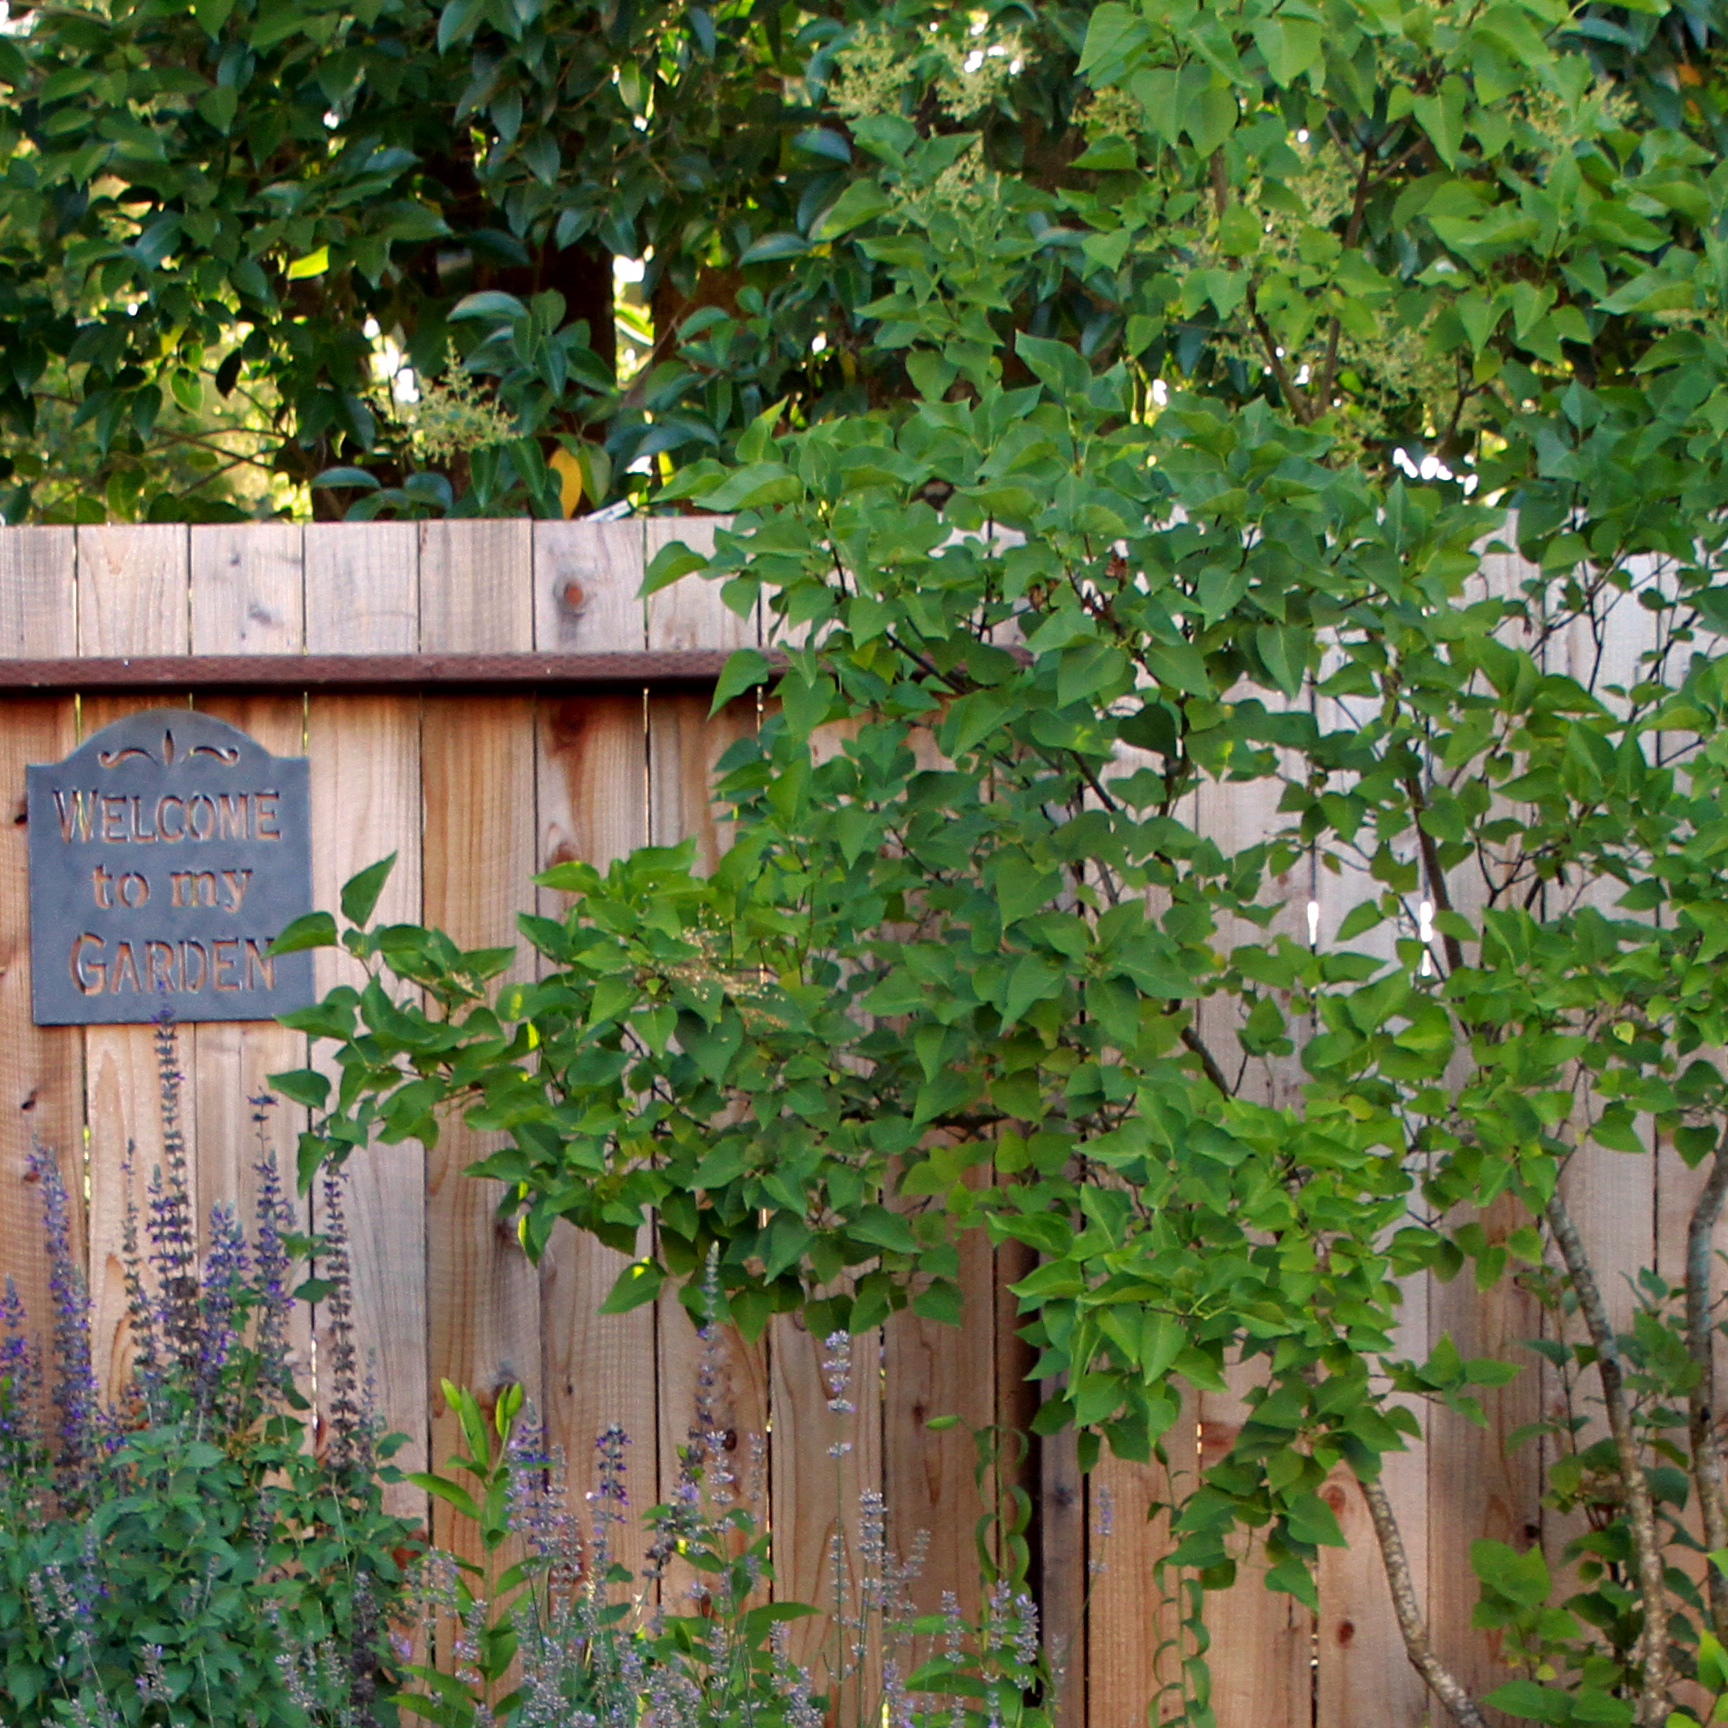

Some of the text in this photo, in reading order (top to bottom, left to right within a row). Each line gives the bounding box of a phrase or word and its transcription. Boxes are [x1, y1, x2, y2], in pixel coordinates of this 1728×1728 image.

[52, 788, 281, 843] WELCOME
[91, 863, 254, 913] to my
[70, 931, 277, 996] GARDEN
